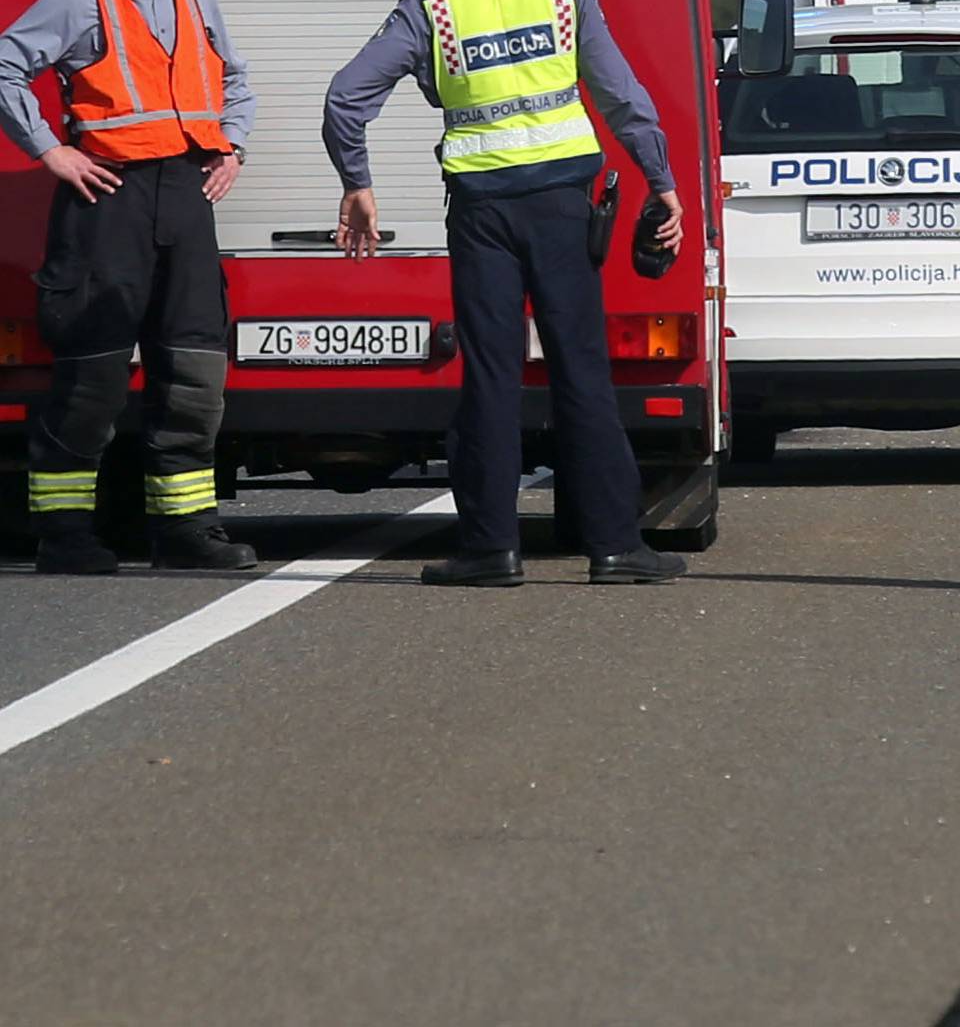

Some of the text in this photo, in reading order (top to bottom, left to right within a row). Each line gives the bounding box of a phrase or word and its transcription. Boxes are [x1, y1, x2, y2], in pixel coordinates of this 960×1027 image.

[466, 32, 553, 64] POLICIJA
[449, 109, 486, 125] LICIJA
[491, 96, 551, 117] POLICIJA
[835, 202, 955, 229] 130 306
[258, 326, 292, 354] ZG
